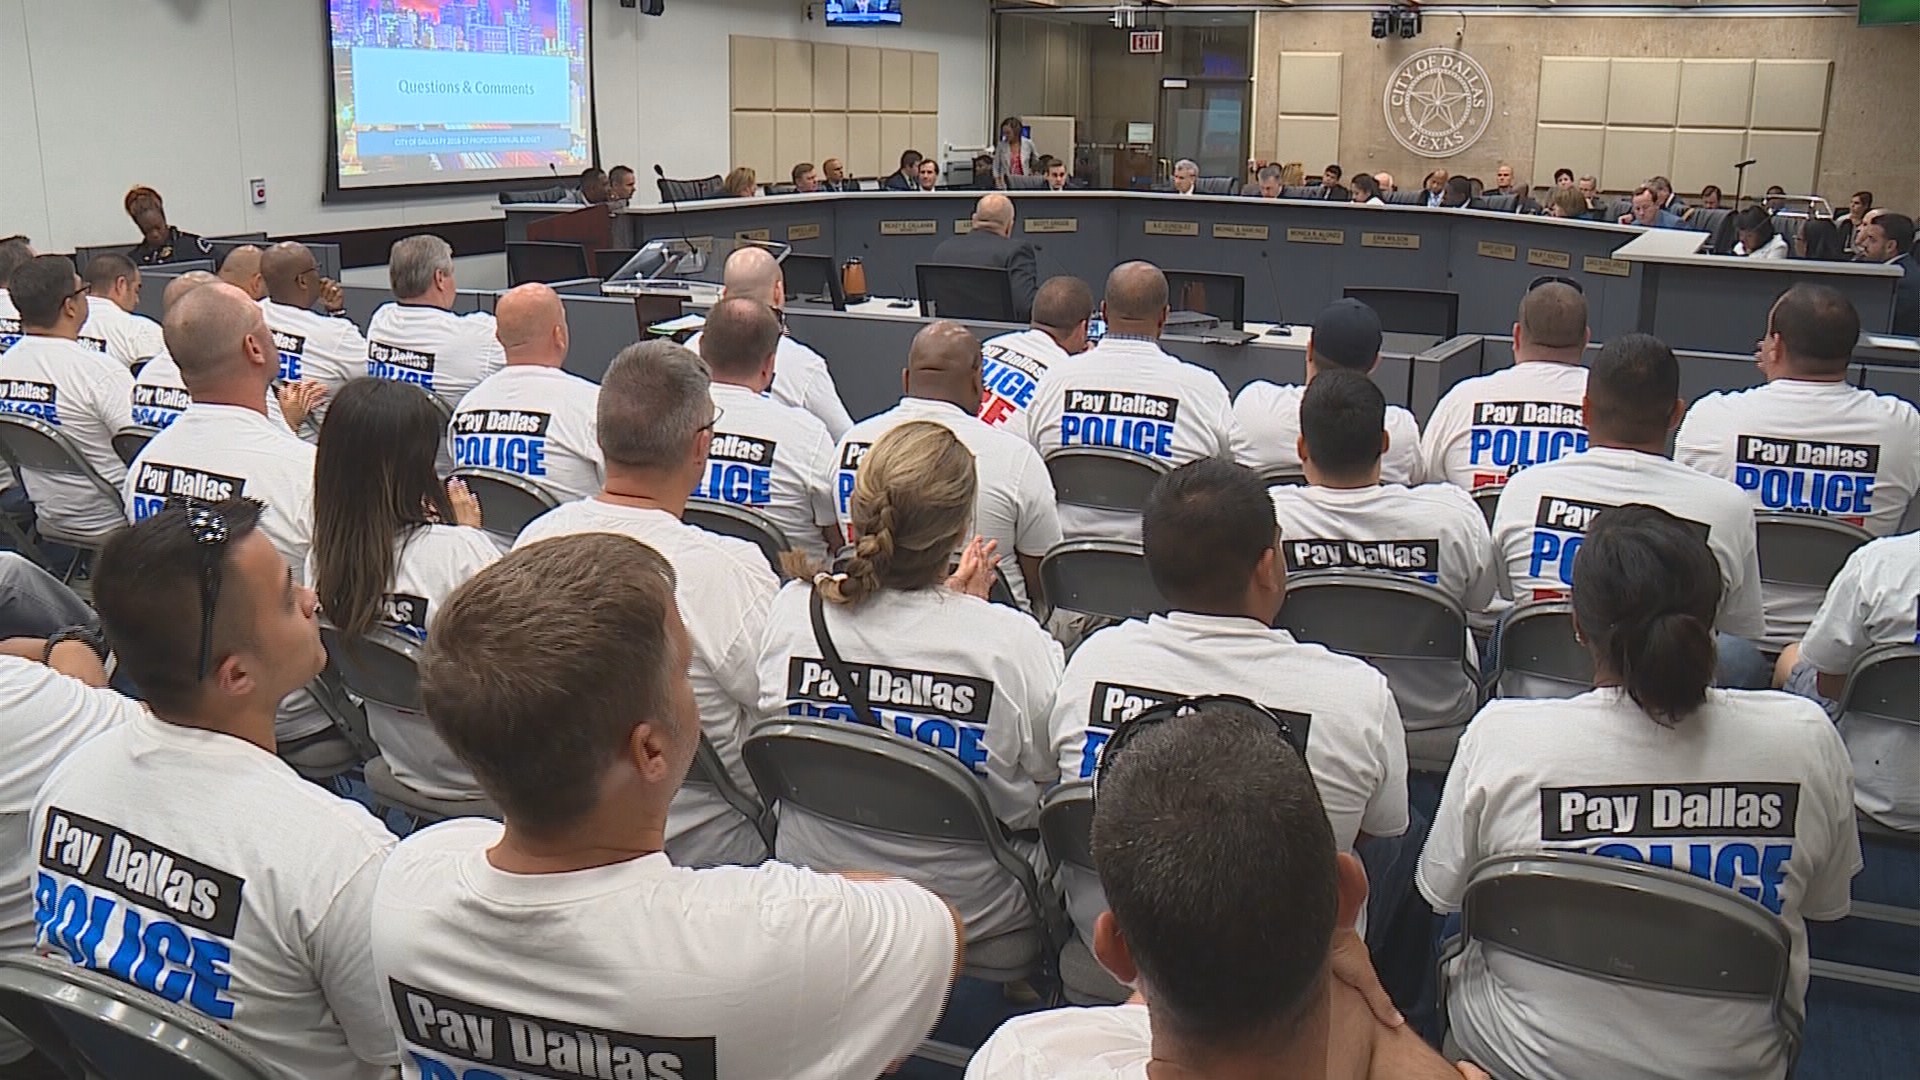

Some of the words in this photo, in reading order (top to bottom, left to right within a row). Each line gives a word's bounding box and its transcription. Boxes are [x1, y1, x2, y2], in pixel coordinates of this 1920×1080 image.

[1135, 35, 1157, 50] EXIT
[398, 79, 460, 96] Questions
[462, 80, 472, 94] &
[475, 81, 535, 96] Comments
[1391, 66, 1414, 106] CITY
[1416, 55, 1437, 72] OF
[1442, 55, 1485, 109] DALLAS
[1408, 128, 1464, 150] TEXAS
[369, 342, 389, 362] Pay
[390, 348, 429, 369] Dallas
[998, 350, 1047, 380] Dallas
[10, 381, 50, 401] Dallas
[136, 385, 154, 404] Pay
[1070, 392, 1105, 413] Pay
[1109, 393, 1169, 416] Dallas
[457, 412, 484, 432] Pay
[486, 411, 541, 432] Dallas
[1481, 403, 1518, 424] Pay
[710, 435, 766, 462] allas
[1062, 415, 1174, 458] POLICE
[455, 436, 547, 476] POLICE
[1747, 438, 1789, 465] Pay
[1795, 443, 1868, 468] Dallas
[139, 464, 169, 494] Pay
[171, 469, 232, 501] Dallas
[1736, 465, 1876, 513] POLICE
[1294, 542, 1341, 567] Pay
[1347, 542, 1427, 568] Dallas
[869, 668, 976, 714] Dallas
[1103, 687, 1163, 723] Pa
[1560, 792, 1639, 833] Pay
[1652, 787, 1782, 829] Dallas
[47, 814, 103, 876] Pay
[105, 833, 220, 920] Dallas
[35, 871, 235, 1020] POLICE
[407, 992, 494, 1060] Pay
[508, 1016, 684, 1080] Dallas
